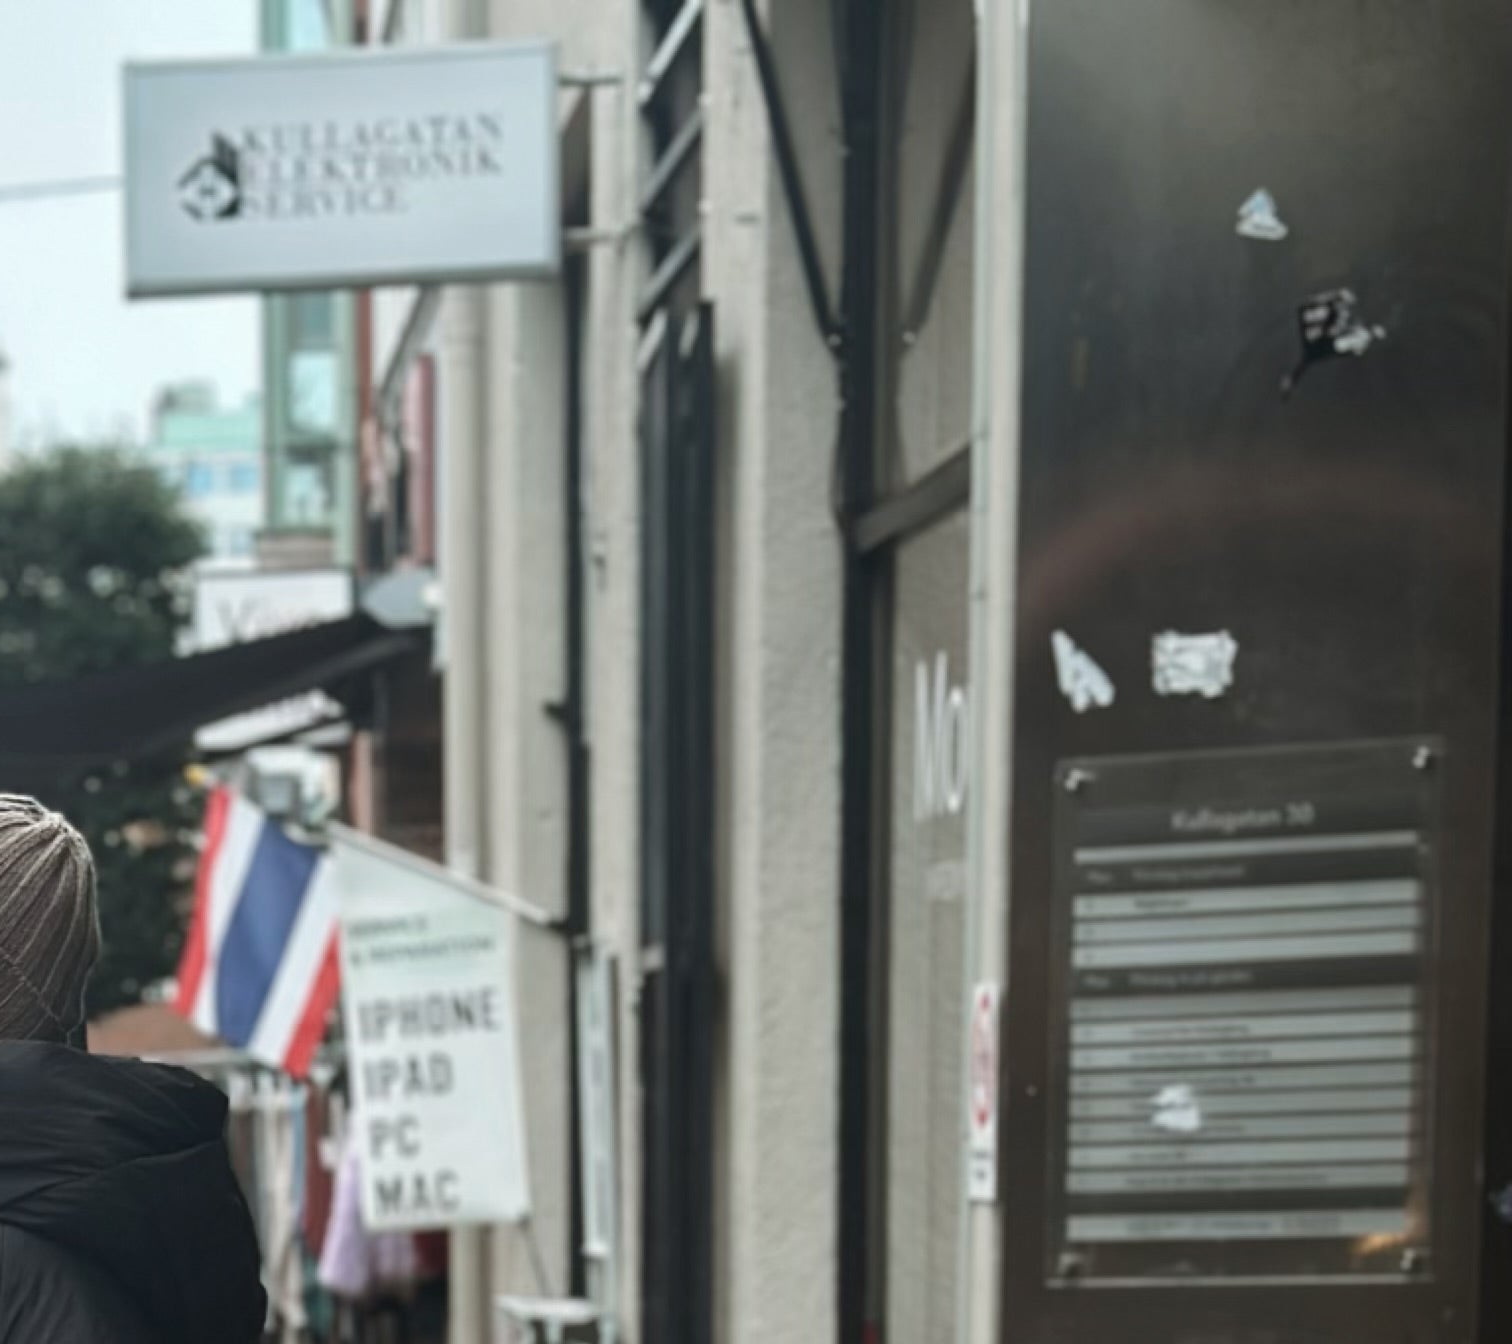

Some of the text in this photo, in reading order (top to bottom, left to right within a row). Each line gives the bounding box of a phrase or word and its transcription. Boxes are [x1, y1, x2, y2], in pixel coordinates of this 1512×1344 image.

[242, 112, 503, 152] KULLAGATAN
[244, 149, 503, 185] ELEKTRONIK
[244, 184, 409, 219] SERVICE
[357, 984, 502, 1043] IPHONE
[363, 1052, 454, 1100] IPAD
[369, 1113, 420, 1160] PC
[373, 1167, 461, 1216] MAC
